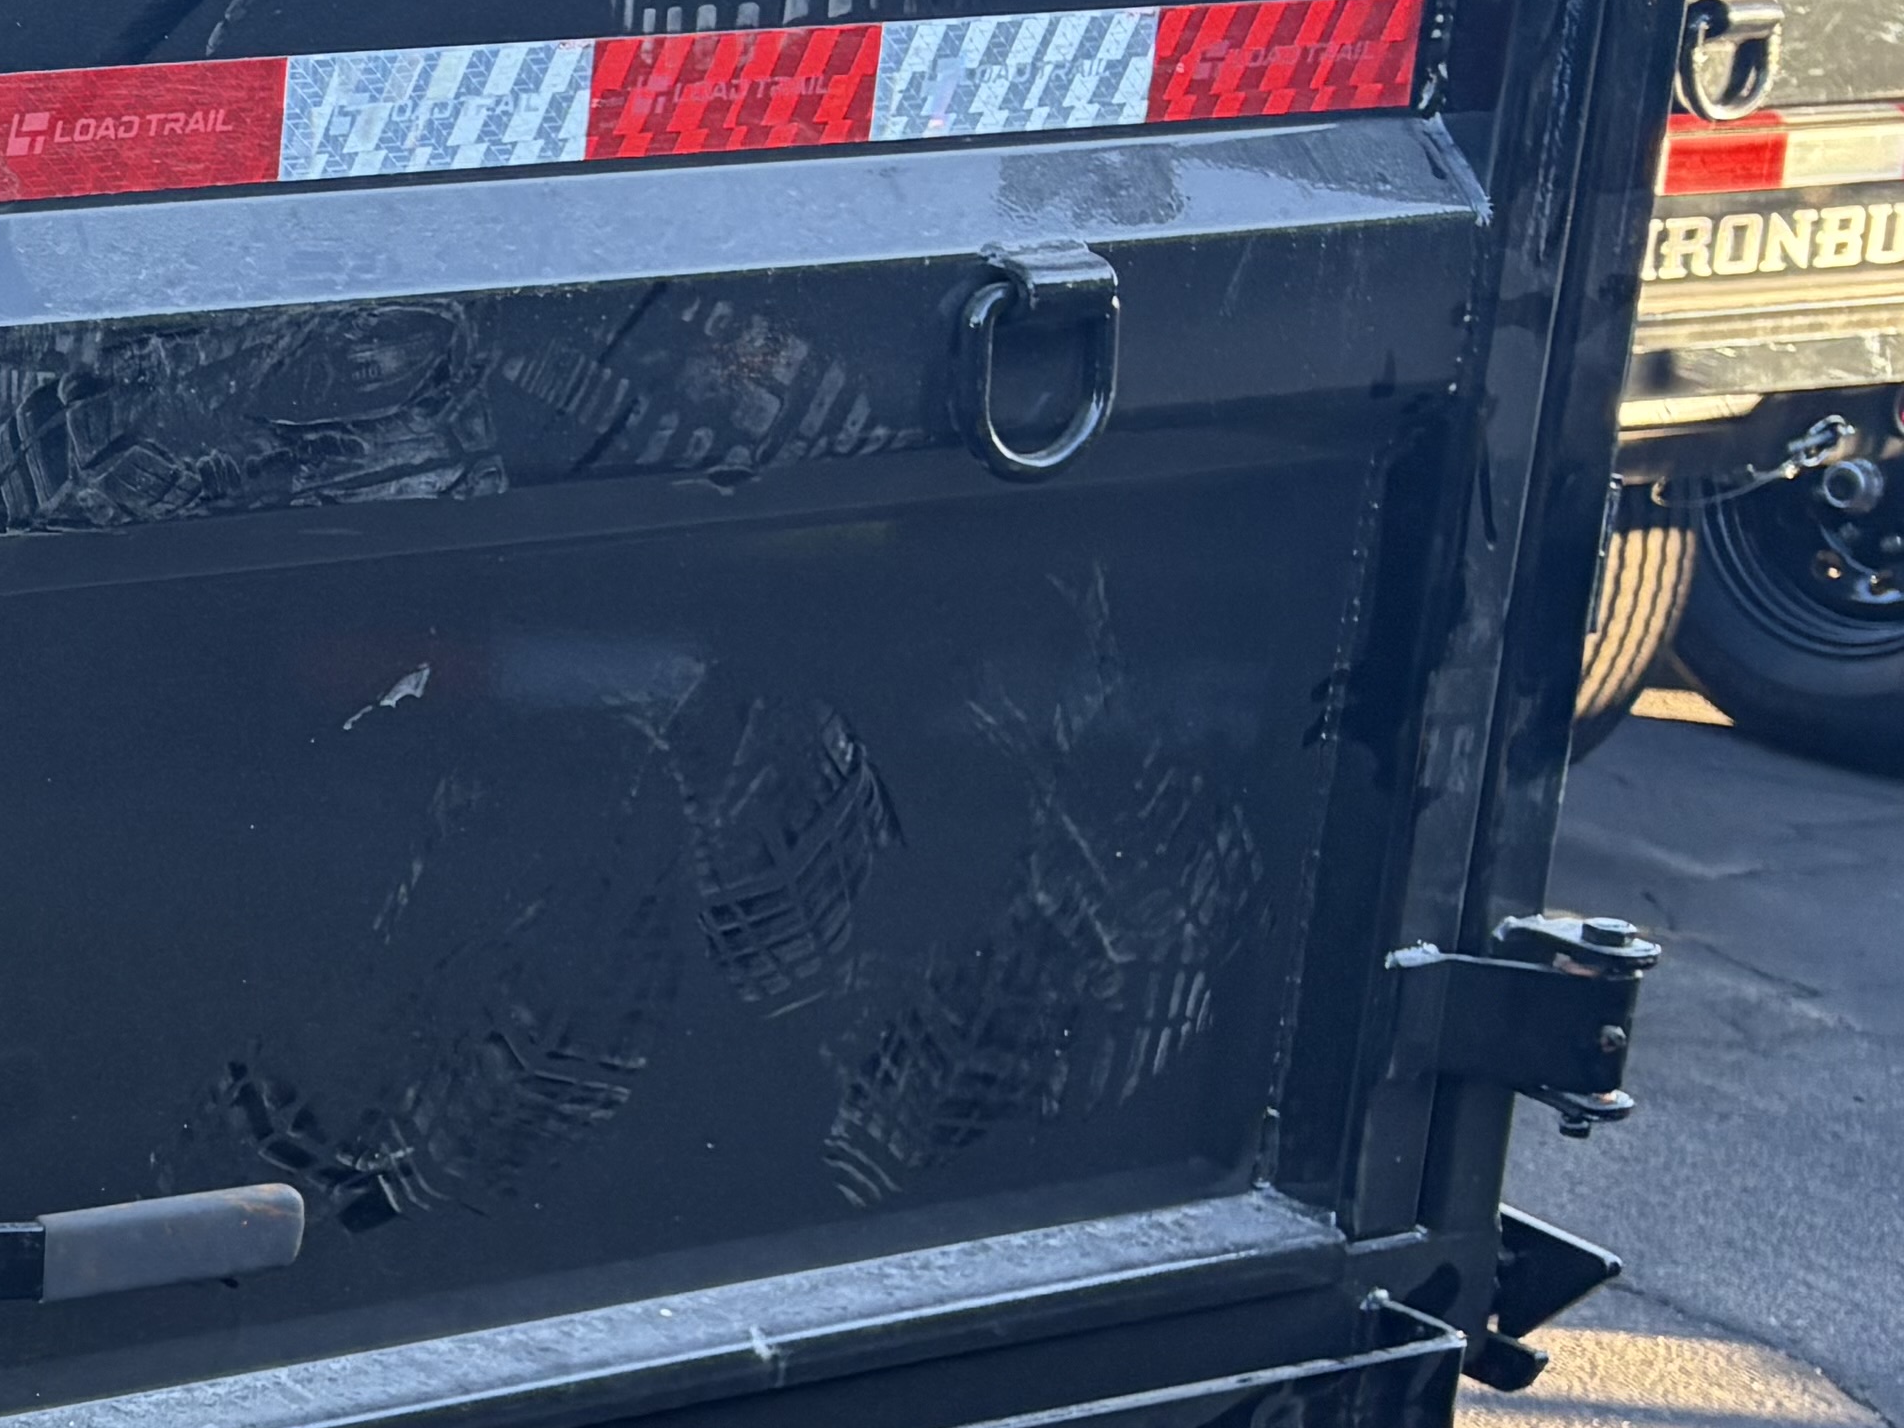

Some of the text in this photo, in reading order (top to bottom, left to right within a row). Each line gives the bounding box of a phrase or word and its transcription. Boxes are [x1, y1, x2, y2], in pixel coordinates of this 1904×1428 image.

[52, 108, 235, 144] LOAD TRAIL
[1641, 203, 1904, 281] IRONBU
